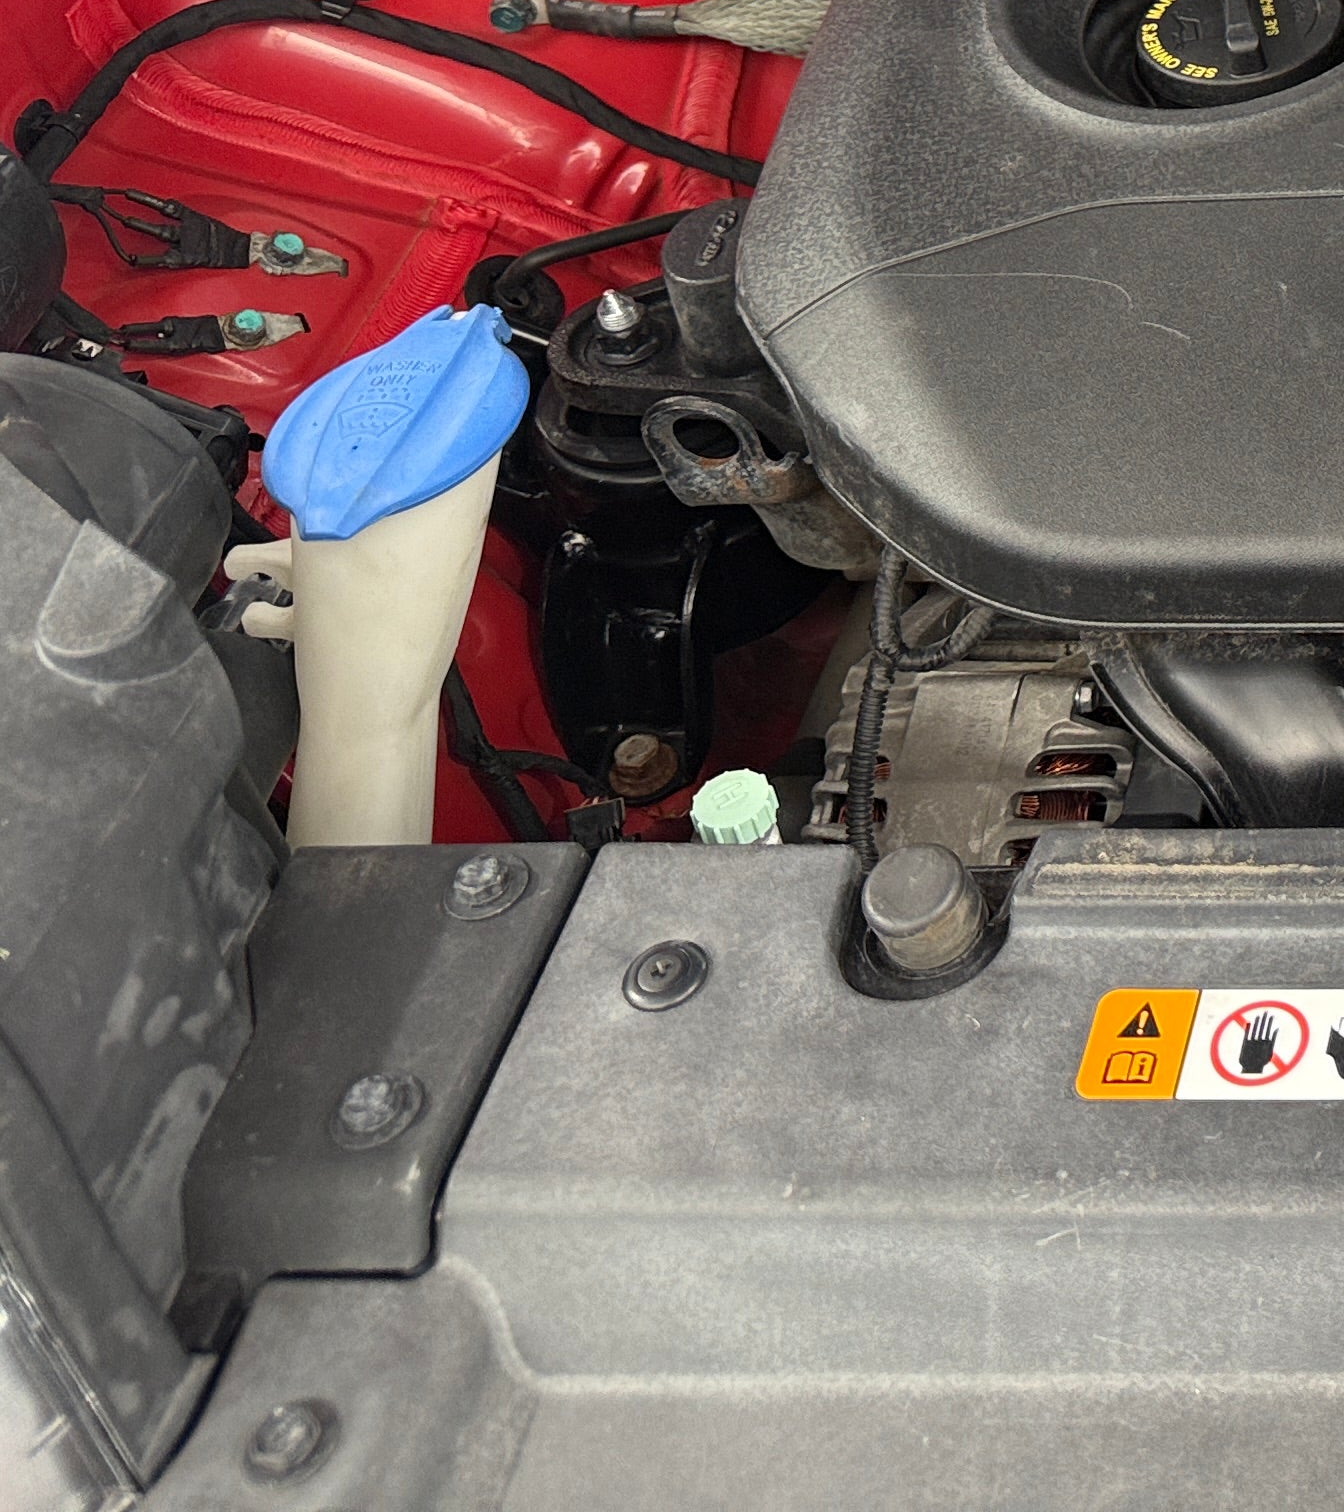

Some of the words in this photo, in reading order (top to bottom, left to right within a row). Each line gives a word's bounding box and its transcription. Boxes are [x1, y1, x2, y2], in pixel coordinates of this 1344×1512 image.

[1265, 17, 1280, 37] SAE
[1140, 21, 1181, 70] OWNER'S
[1180, 62, 1219, 80] SEE
[366, 360, 442, 376] WASHER
[370, 374, 417, 386] ONLY
